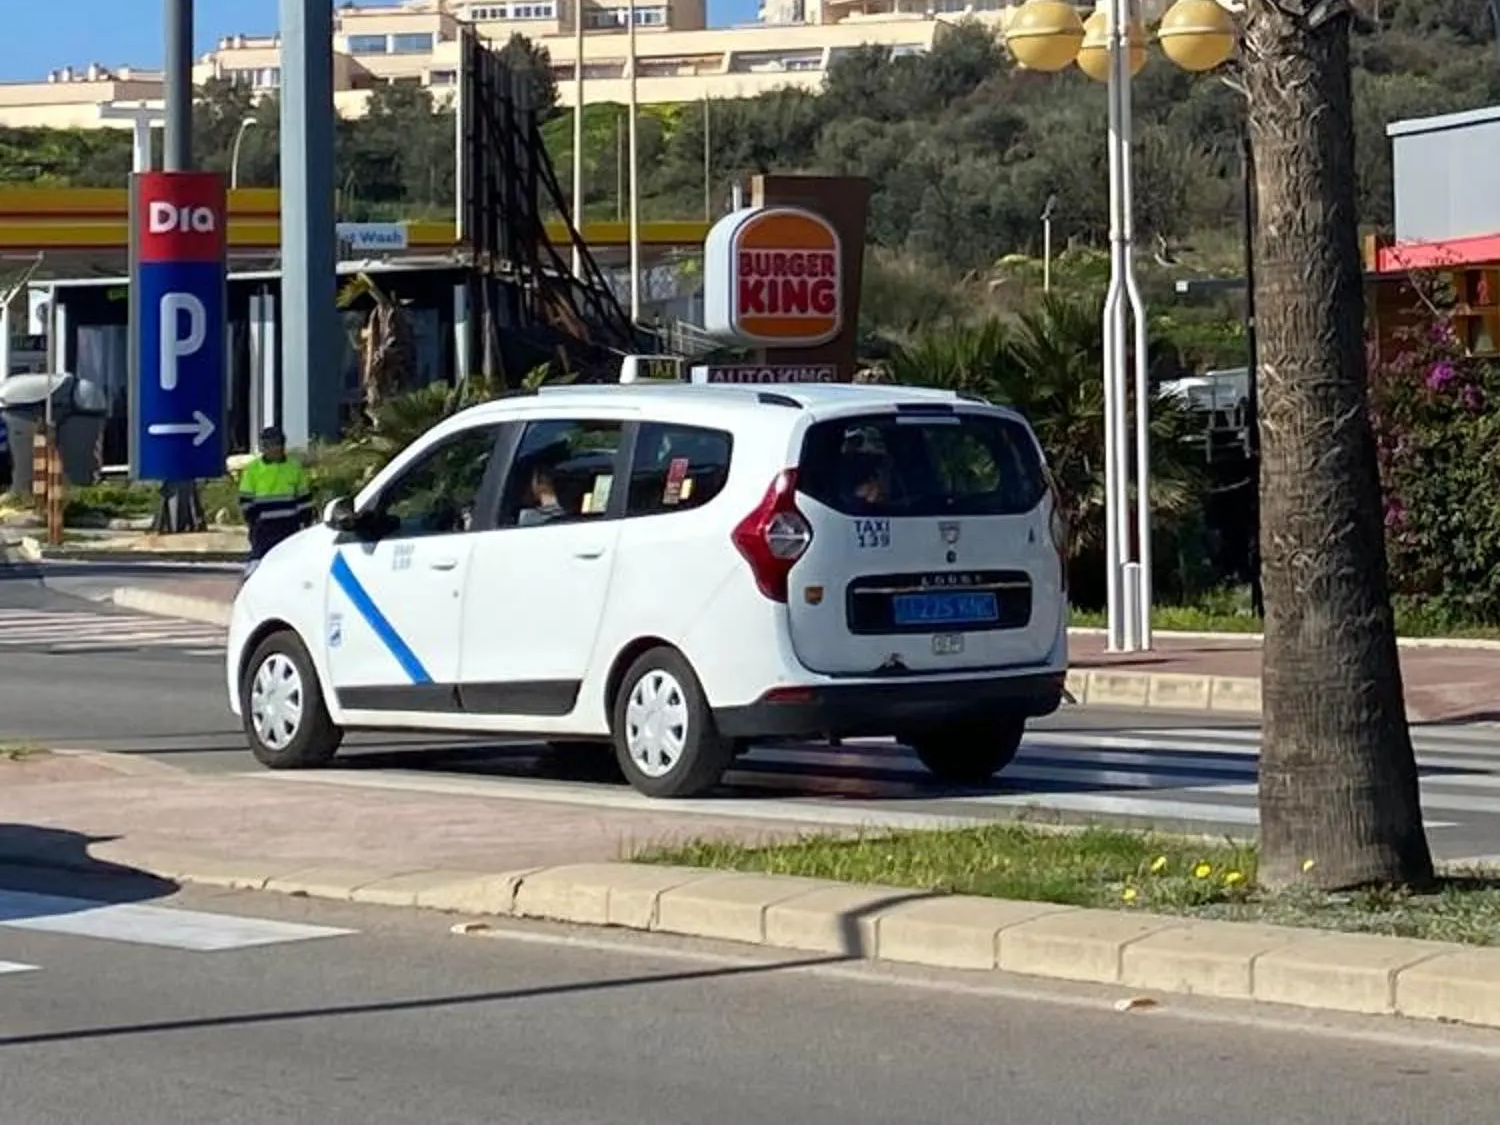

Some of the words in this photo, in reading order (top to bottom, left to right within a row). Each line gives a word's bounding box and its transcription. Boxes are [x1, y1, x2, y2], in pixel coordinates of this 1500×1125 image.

[739, 251, 836, 278] BURGER
[739, 278, 836, 314] KING
[160, 292, 206, 390] P
[854, 519, 890, 532] TAXI
